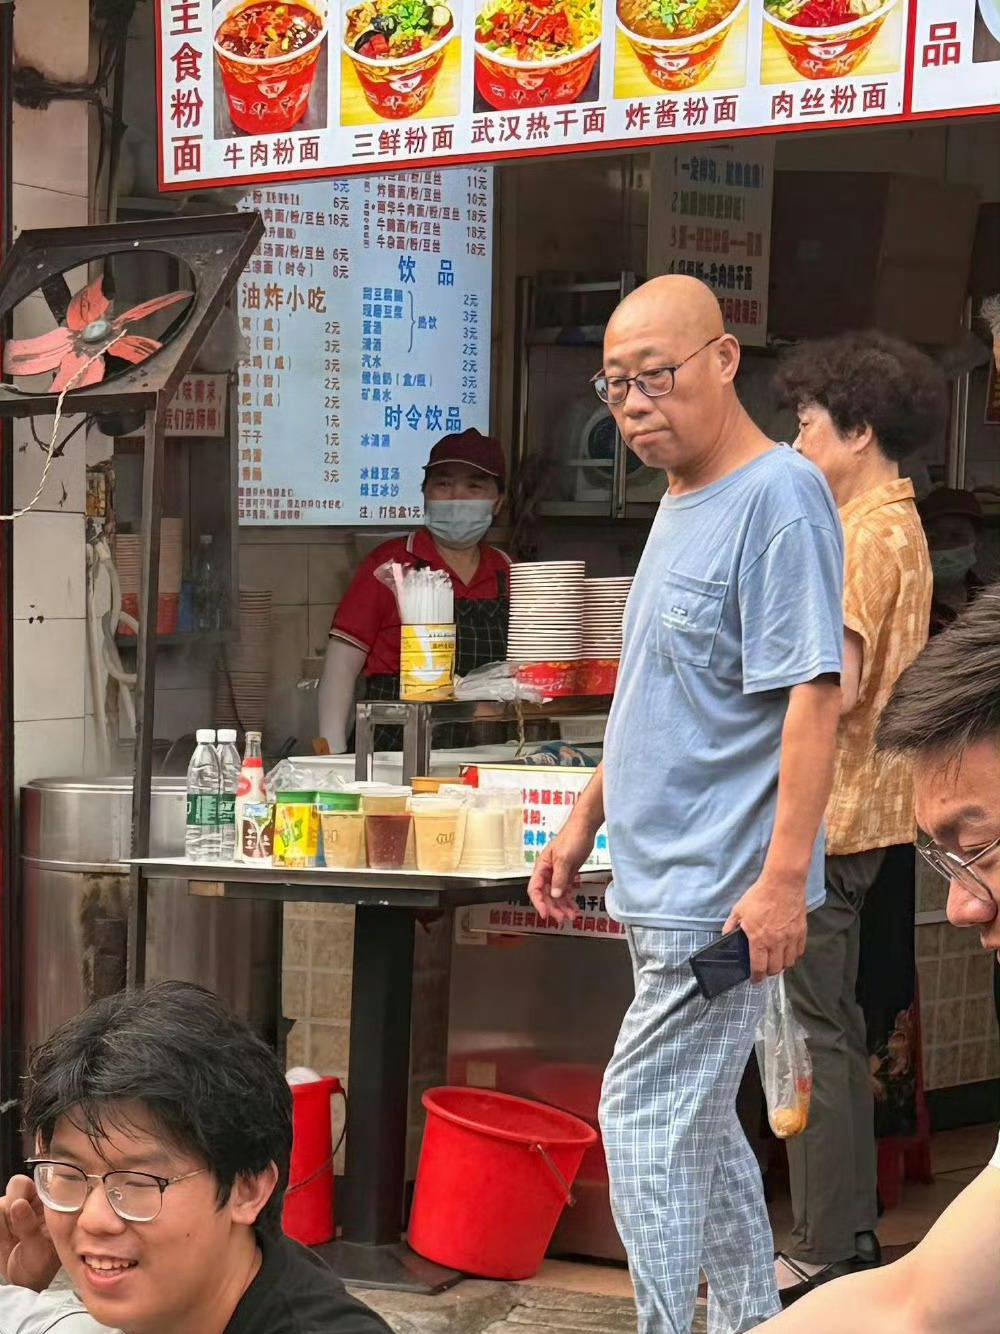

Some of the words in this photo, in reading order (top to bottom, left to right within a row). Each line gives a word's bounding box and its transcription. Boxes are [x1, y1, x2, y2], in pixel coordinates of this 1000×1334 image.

[170, 0, 204, 176] 主食粉面
[771, 82, 889, 120] 肉丝粉面
[471, 107, 607, 144] 武汉热干面
[625, 95, 739, 131] 炸酱粉面
[223, 136, 321, 169] 牛肉粉面
[351, 124, 455, 157] 三鲜粉面
[398, 255, 455, 287] 饮品
[242, 282, 327, 313] 油炸小吃
[384, 404, 462, 431] 时令饮品
